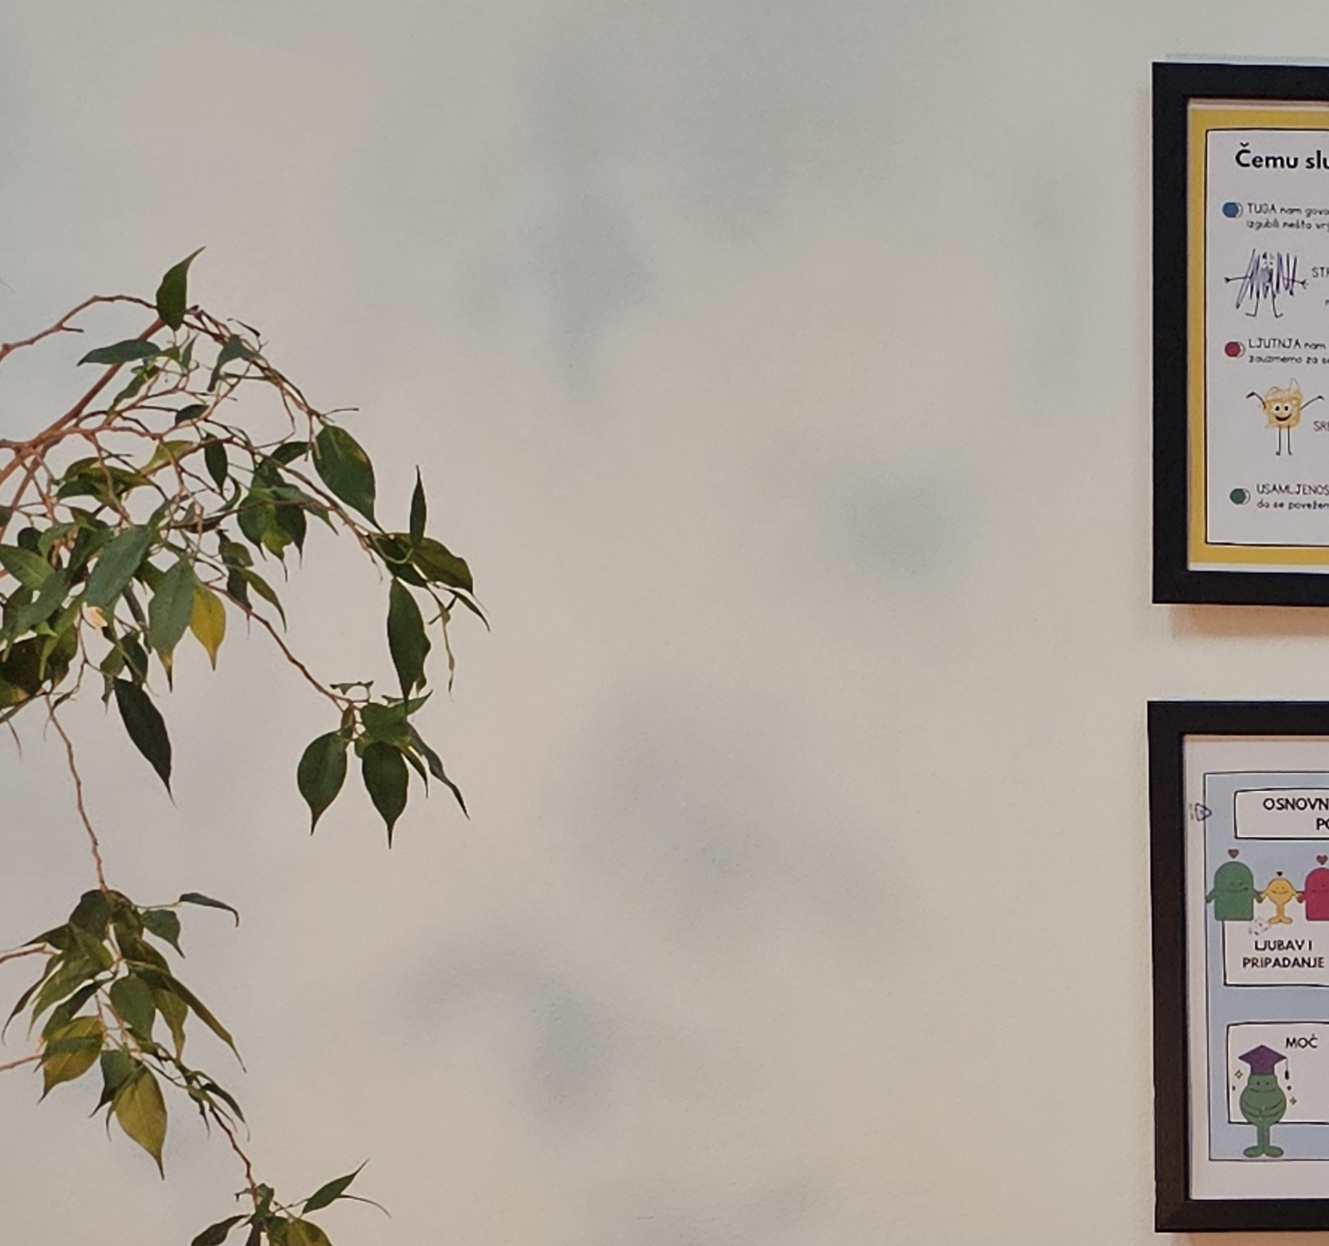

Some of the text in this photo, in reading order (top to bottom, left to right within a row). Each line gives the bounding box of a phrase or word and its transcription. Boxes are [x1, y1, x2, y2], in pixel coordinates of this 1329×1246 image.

[1236, 142, 1298, 169] Čemu
[1248, 203, 1276, 214] TUGA
[1248, 338, 1301, 349] LJUTNJA
[1255, 939, 1304, 951] LJUBAV
[1242, 956, 1324, 969] PRIPADANJE
[1285, 1034, 1319, 1049] MOĆ
